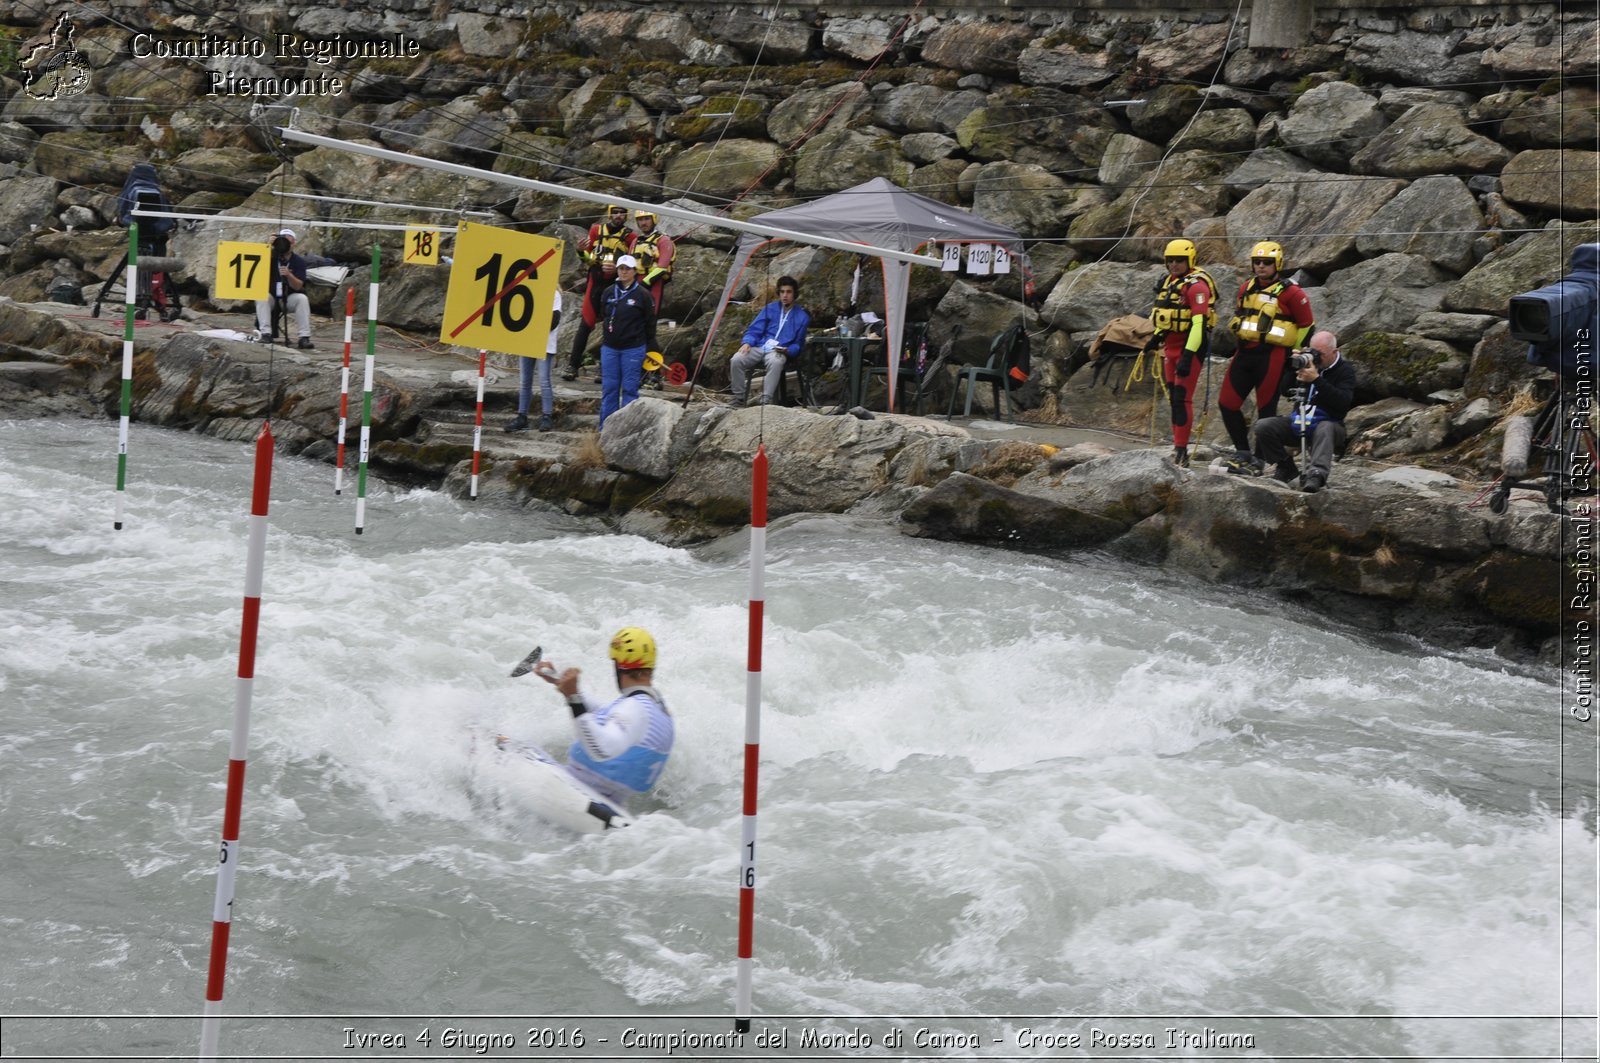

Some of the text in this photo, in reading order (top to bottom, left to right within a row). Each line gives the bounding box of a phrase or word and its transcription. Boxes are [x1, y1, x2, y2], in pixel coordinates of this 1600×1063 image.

[413, 231, 432, 257] 18
[946, 247, 959, 261] 18
[980, 251, 990, 264] 20
[996, 249, 1009, 263] 21
[228, 253, 261, 289] 17
[474, 252, 539, 333] 16
